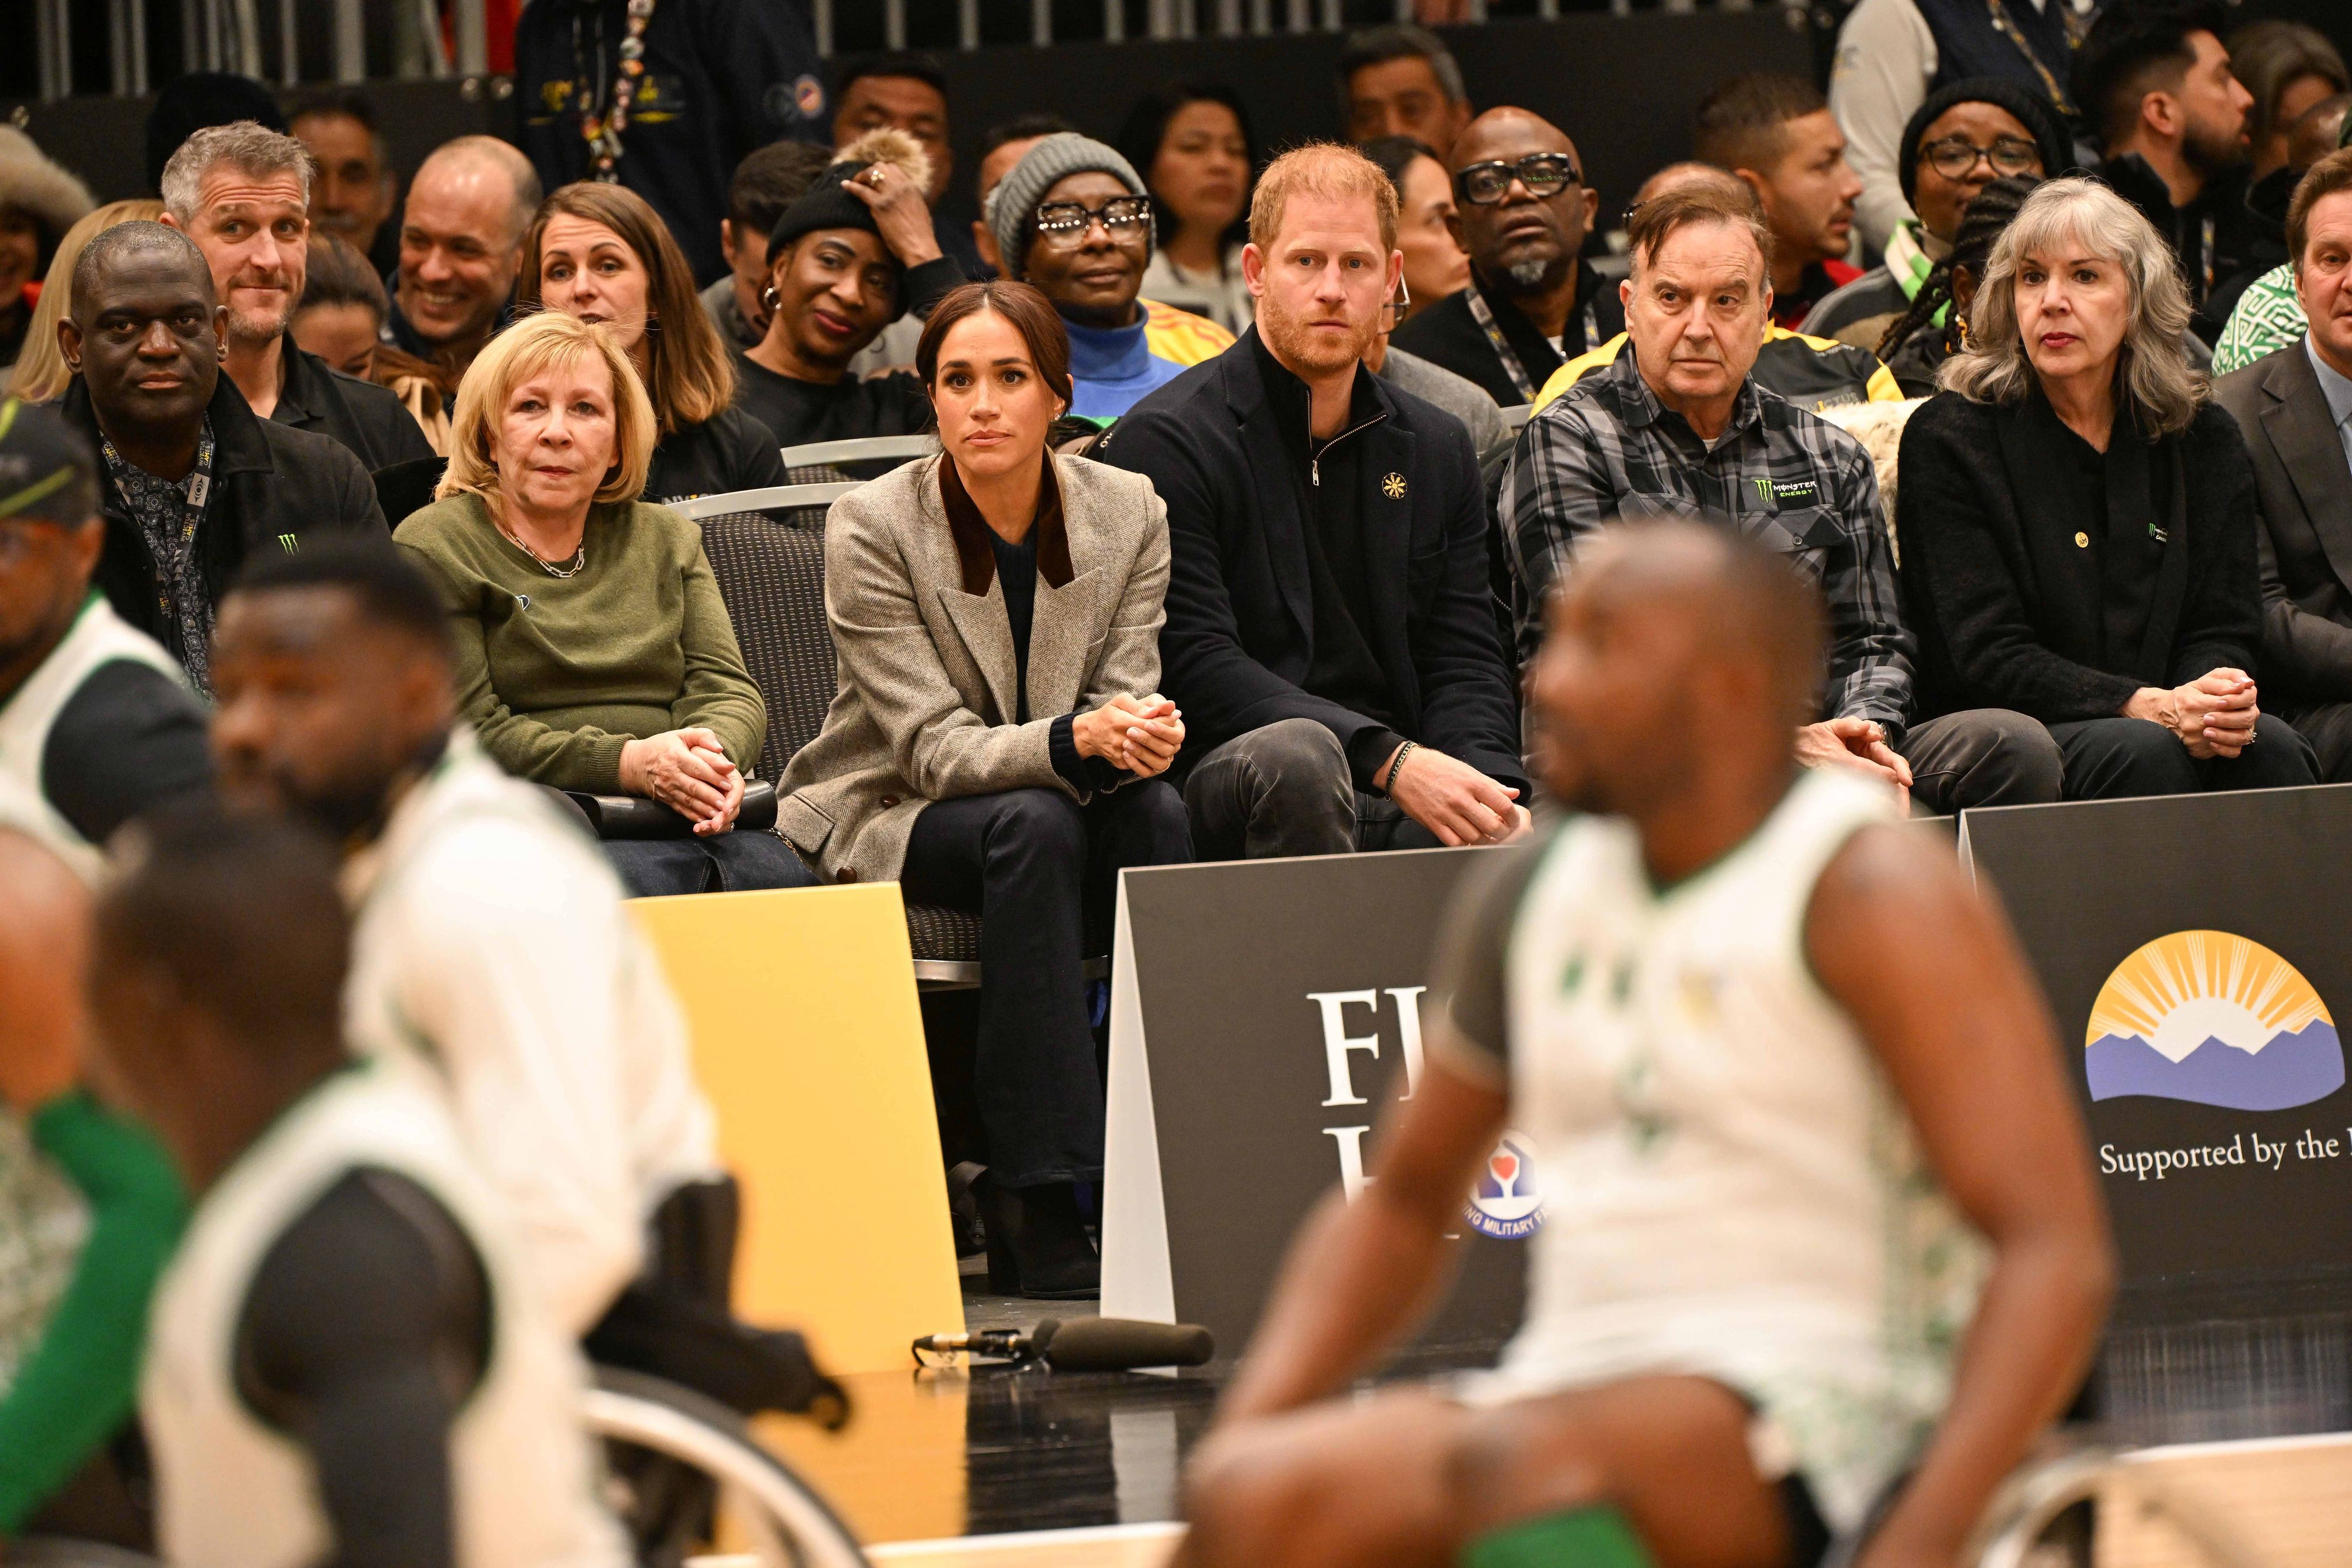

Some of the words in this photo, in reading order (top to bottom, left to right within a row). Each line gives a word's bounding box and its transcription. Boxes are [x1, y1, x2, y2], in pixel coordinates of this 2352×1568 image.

[103, 443, 115, 464] GAMES
[106, 440, 122, 466] INVICTUS
[1773, 480, 1818, 492] MONSTER
[1780, 489, 1813, 497] ENERGY
[181, 512, 191, 542] INVICTUS
[185, 518, 195, 540] GAMES
[2100, 1134, 2246, 1181] Supported
[2251, 1132, 2287, 1171] by
[2296, 1128, 2340, 1160] the
[1482, 1216, 1535, 1236] MILITARY
